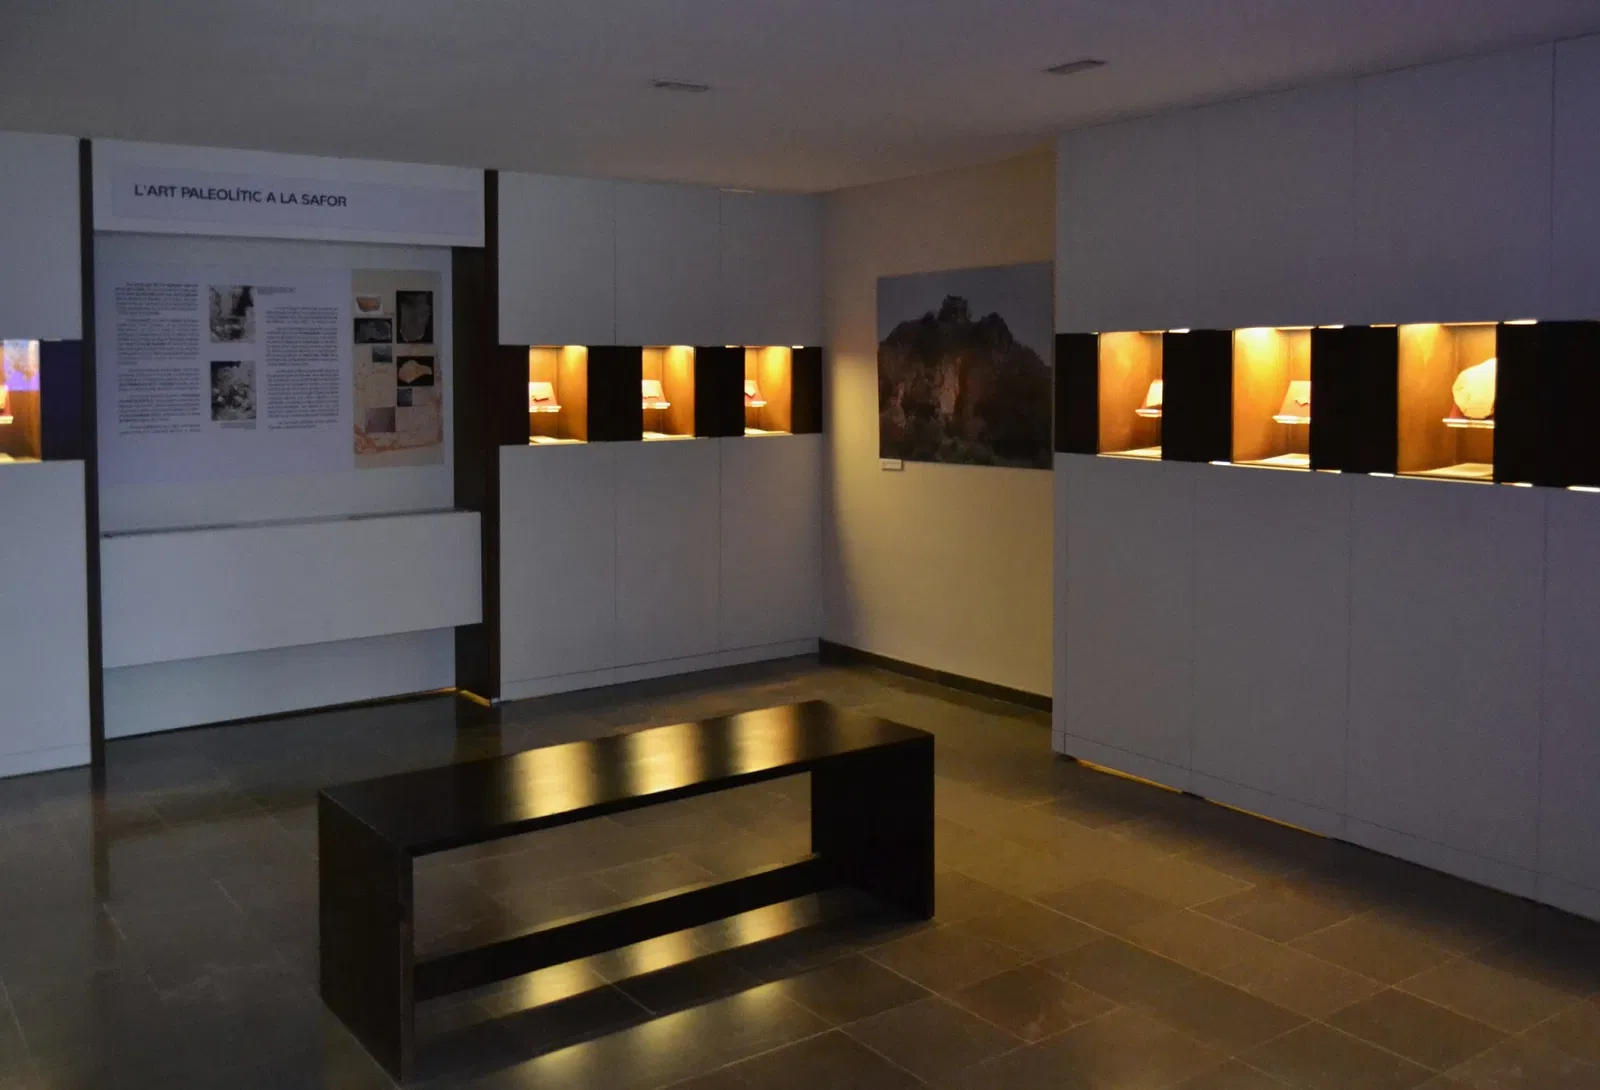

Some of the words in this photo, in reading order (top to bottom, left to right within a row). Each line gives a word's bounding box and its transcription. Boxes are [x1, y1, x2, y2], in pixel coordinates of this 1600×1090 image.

[134, 184, 177, 198] L'ART
[182, 187, 262, 203] PALEOLÍTIC
[267, 193, 277, 204] A
[280, 193, 298, 205] LA
[302, 194, 347, 207] SAFOR
